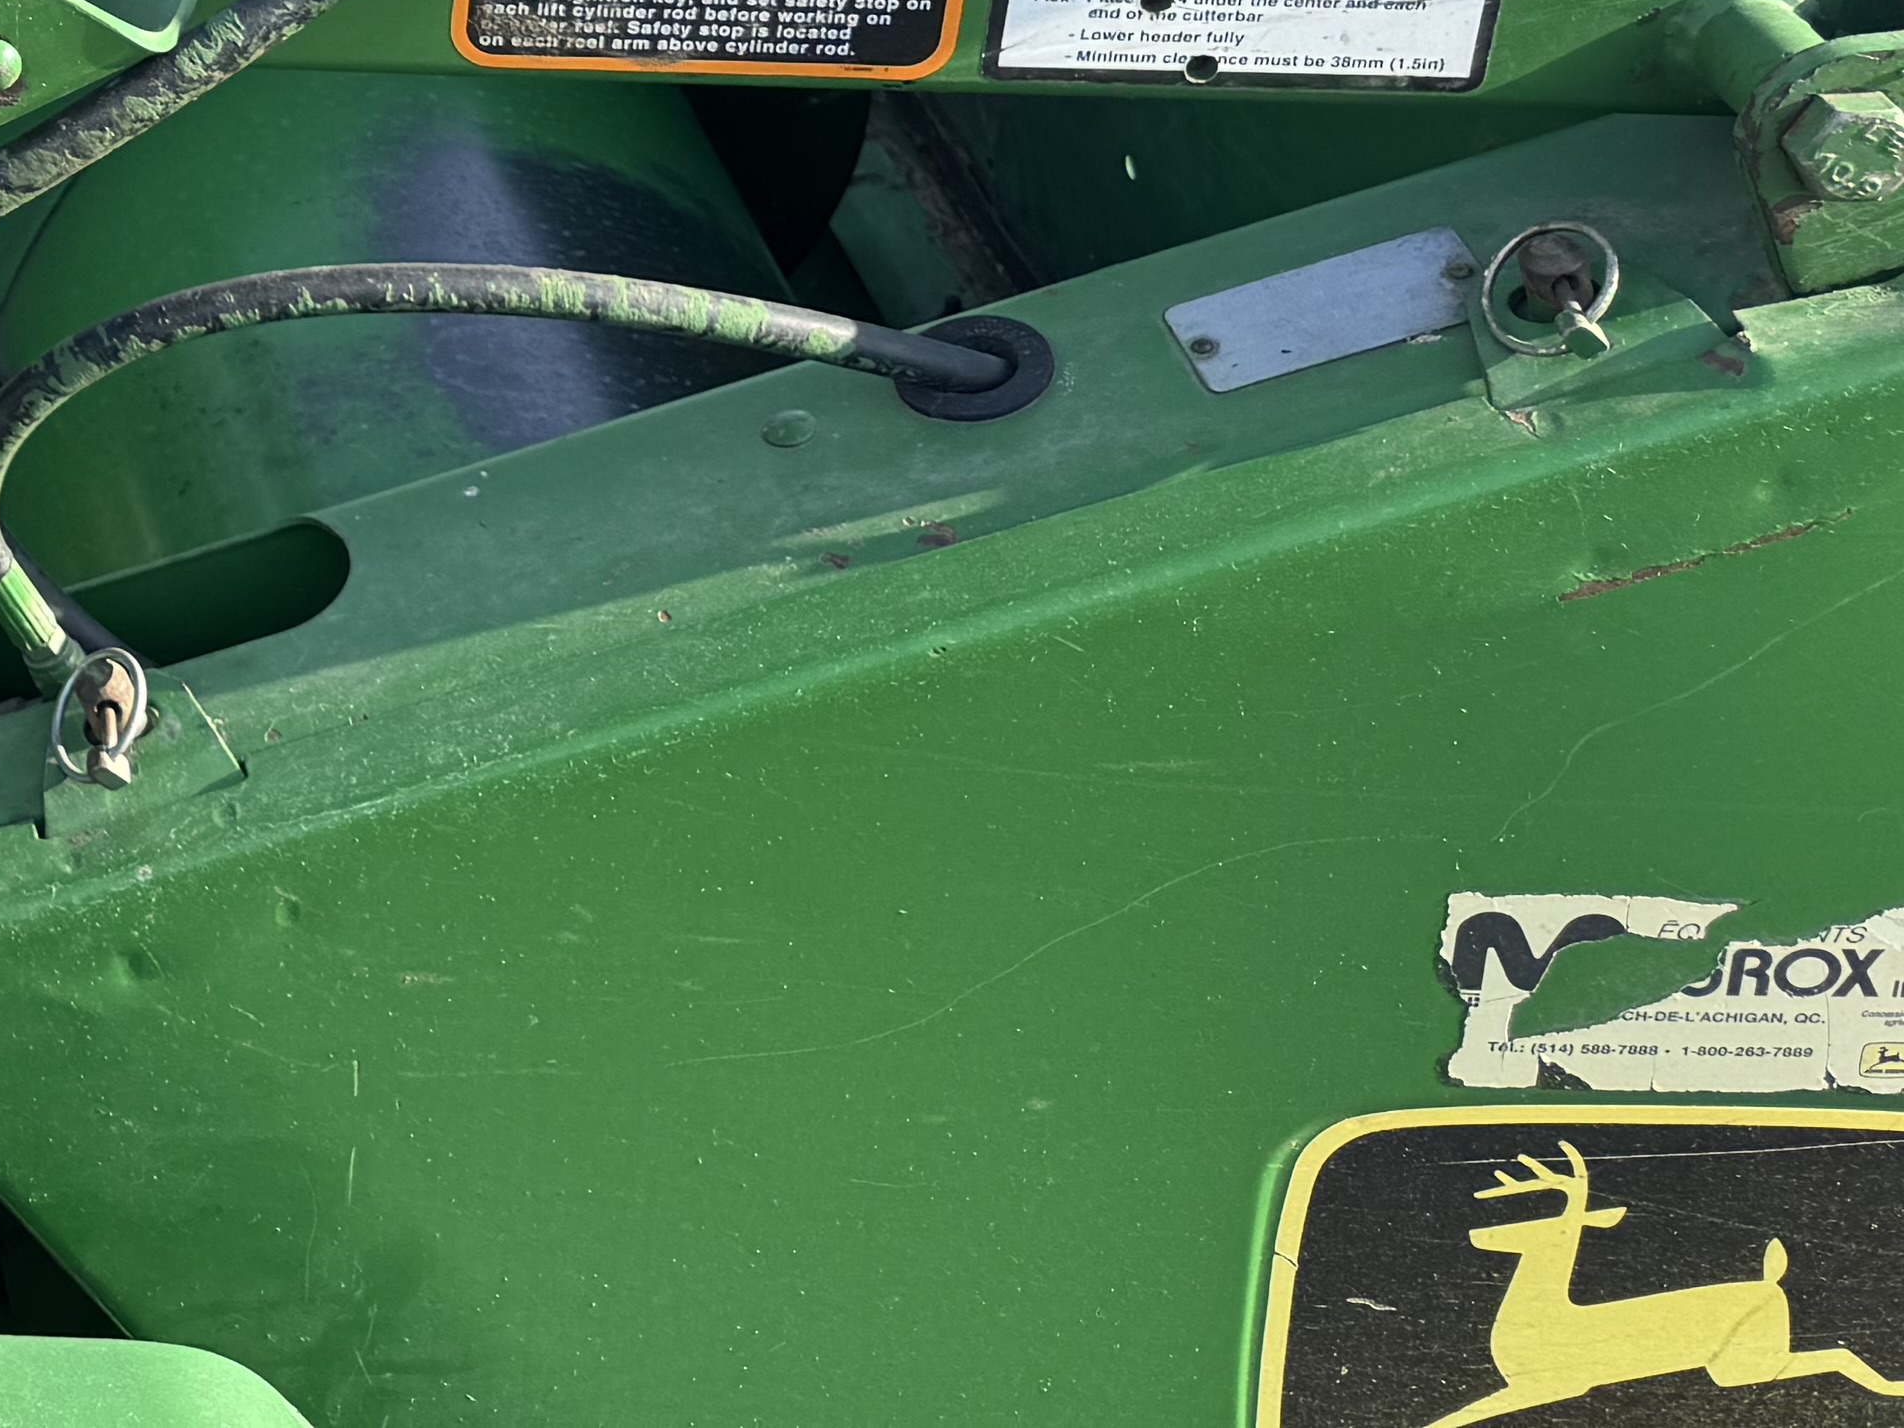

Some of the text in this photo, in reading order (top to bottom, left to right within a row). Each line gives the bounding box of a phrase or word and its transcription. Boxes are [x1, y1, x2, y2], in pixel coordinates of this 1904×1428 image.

[906, 0, 932, 11] on
[1383, 0, 1428, 12] each
[537, 2, 566, 17] lift
[572, 3, 657, 20] cylinder
[663, 7, 698, 20] rod
[704, 7, 771, 22] before
[778, 10, 860, 27] working
[866, 14, 892, 25] on
[1088, 8, 1121, 20] end
[1182, 11, 1264, 24] cutterbar
[627, 20, 692, 37] Safety
[699, 24, 744, 40] stop
[751, 24, 769, 37] is
[776, 25, 852, 41] located
[1080, 29, 1134, 42] Lower
[1140, 30, 1202, 43] header
[1206, 31, 1245, 47] fully
[478, 34, 856, 56] on each reel arm above cylinder rod.
[1076, 50, 1156, 64] Minimum
[1163, 51, 1248, 66] clence
[1254, 55, 1298, 68] must
[1304, 55, 1326, 68] be
[1330, 56, 1384, 69] 38mm
[1389, 57, 1445, 72] (1.5in)
[1794, 1012, 1826, 1024] QC.
[1531, 1043, 1574, 1056] (514)
[1580, 1043, 1659, 1057] 588-7888
[1681, 1047, 1814, 1058] 1-800-263-7889
